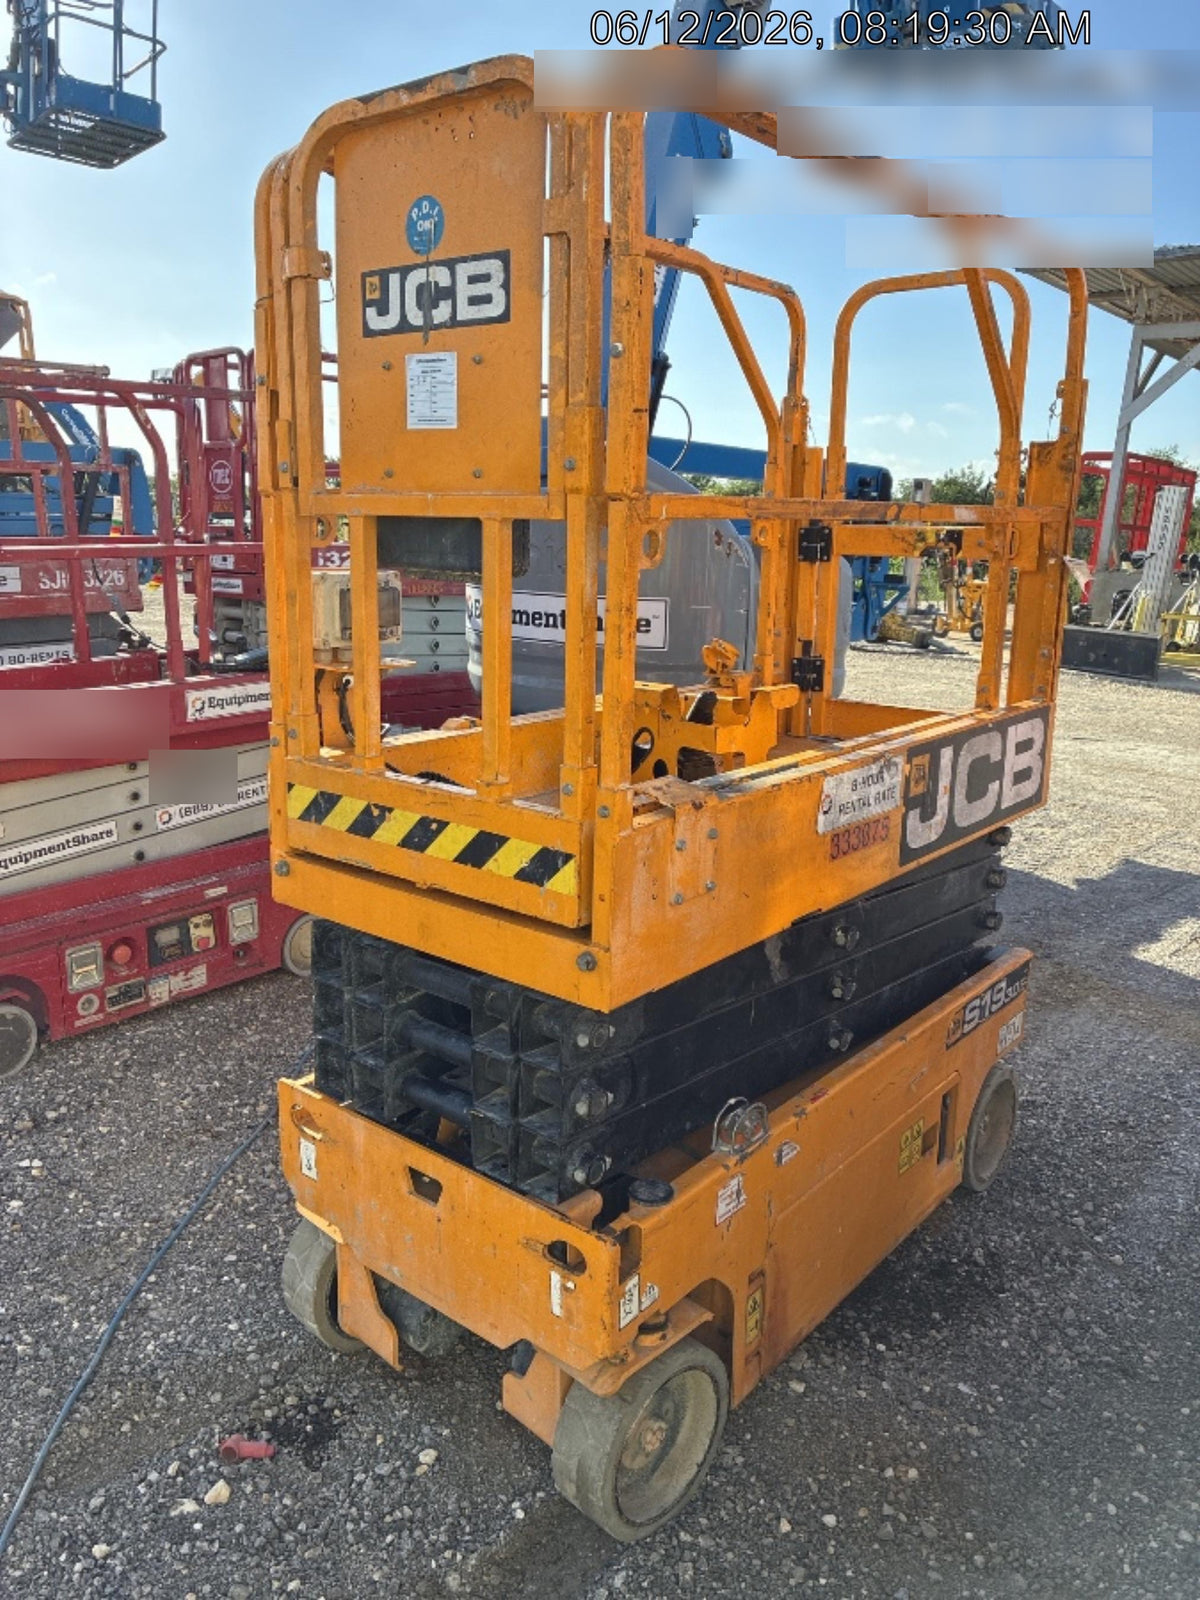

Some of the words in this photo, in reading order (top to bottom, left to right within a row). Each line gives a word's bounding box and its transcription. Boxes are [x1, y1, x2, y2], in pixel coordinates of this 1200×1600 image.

[365, 258, 506, 331] JCB
[906, 717, 1045, 849] JCB
[0, 827, 115, 871] quipmentShare
